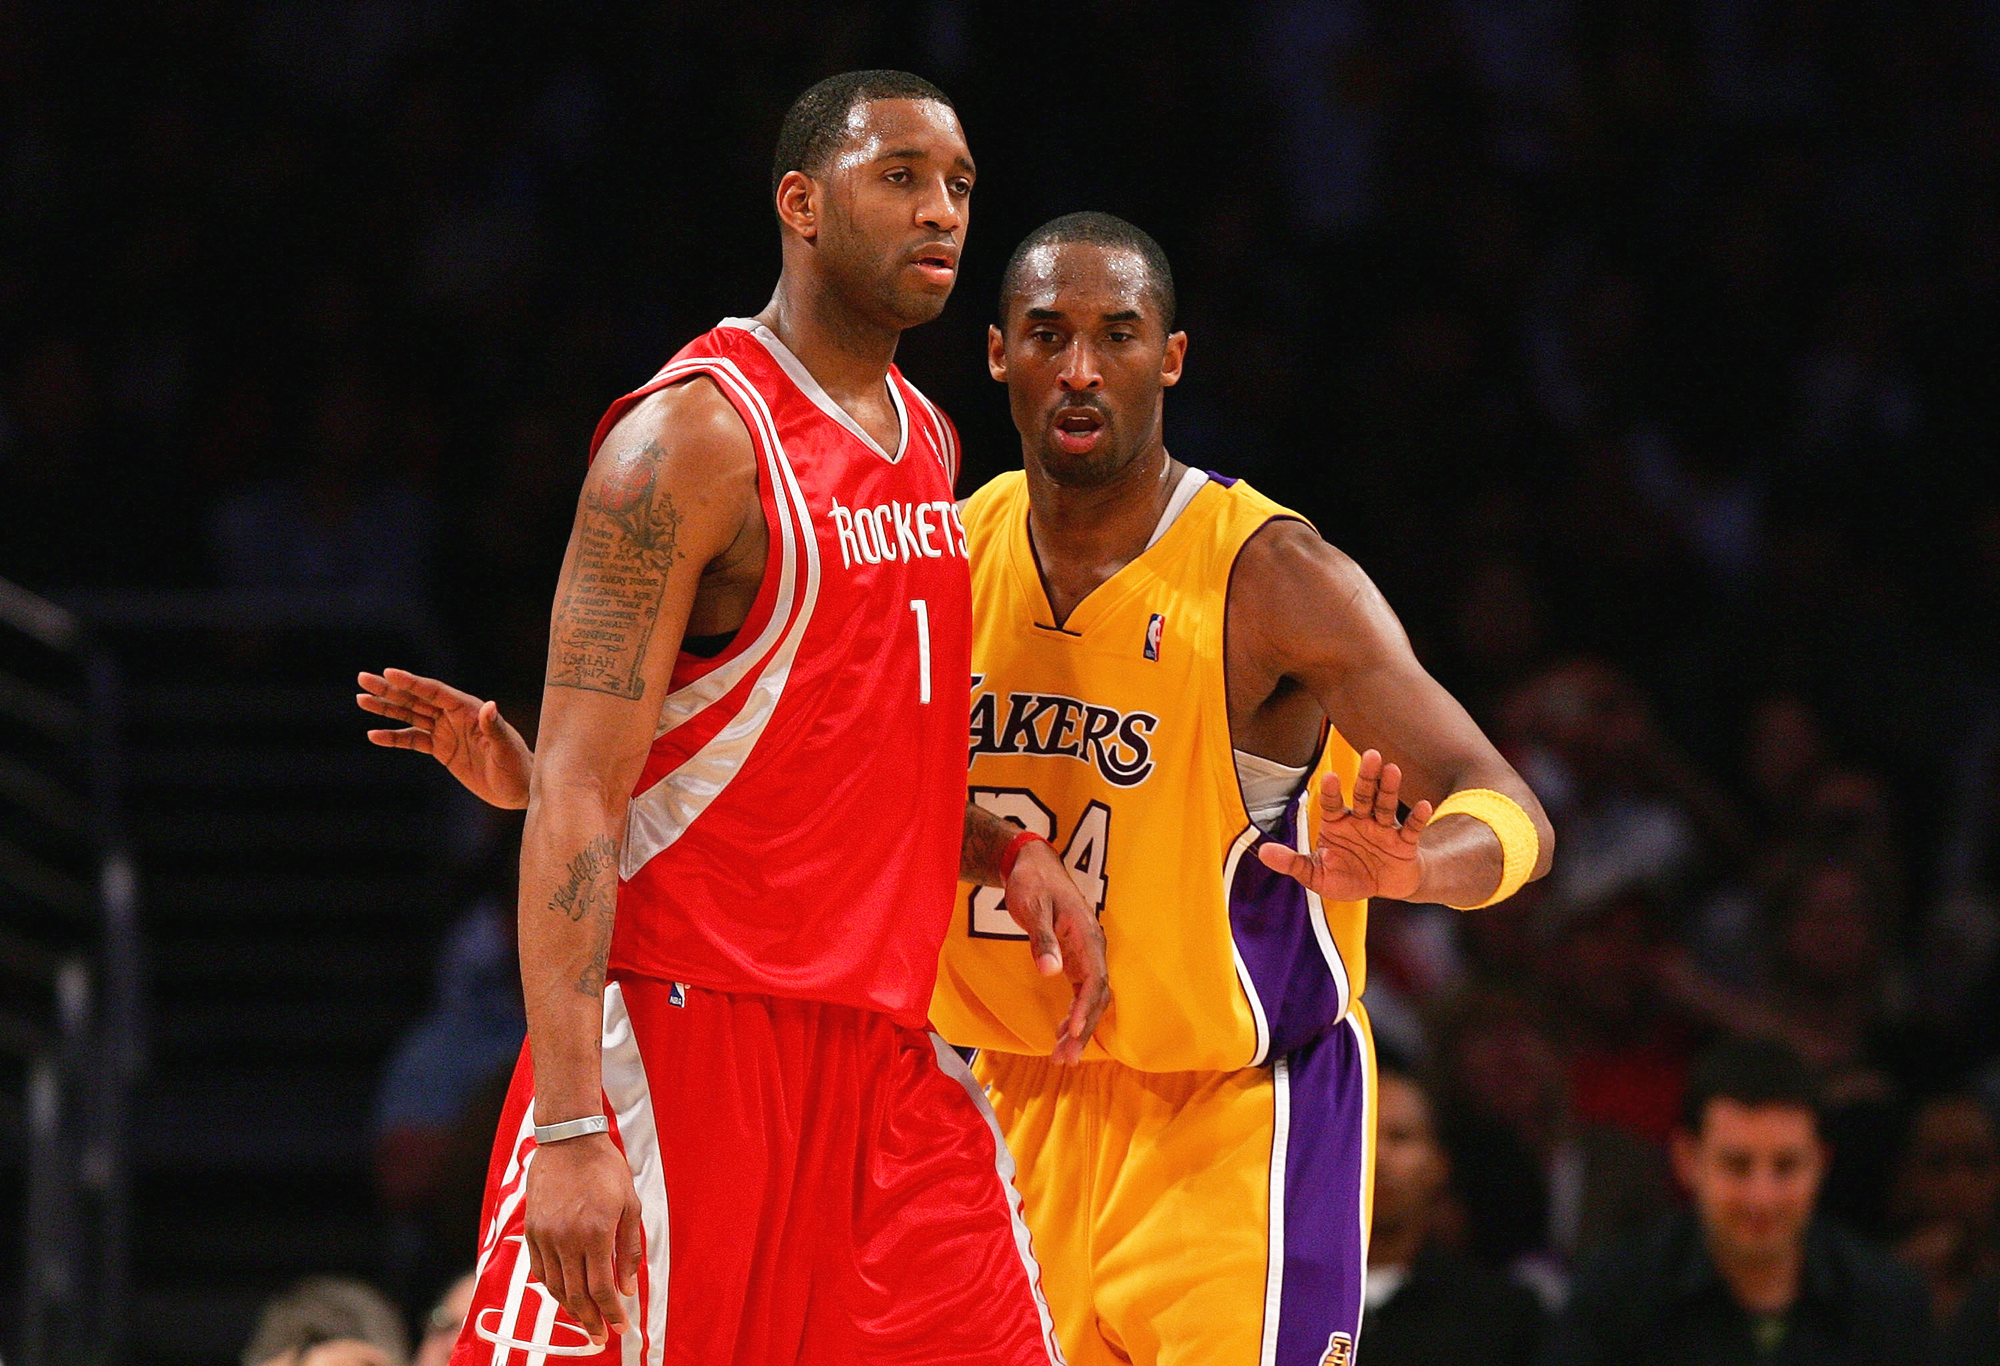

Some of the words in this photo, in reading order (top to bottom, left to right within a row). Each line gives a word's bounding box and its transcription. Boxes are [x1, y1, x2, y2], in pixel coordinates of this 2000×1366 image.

[827, 496, 970, 570] ROCKETS
[910, 599, 931, 705] 1
[968, 674, 1160, 789] AKERS
